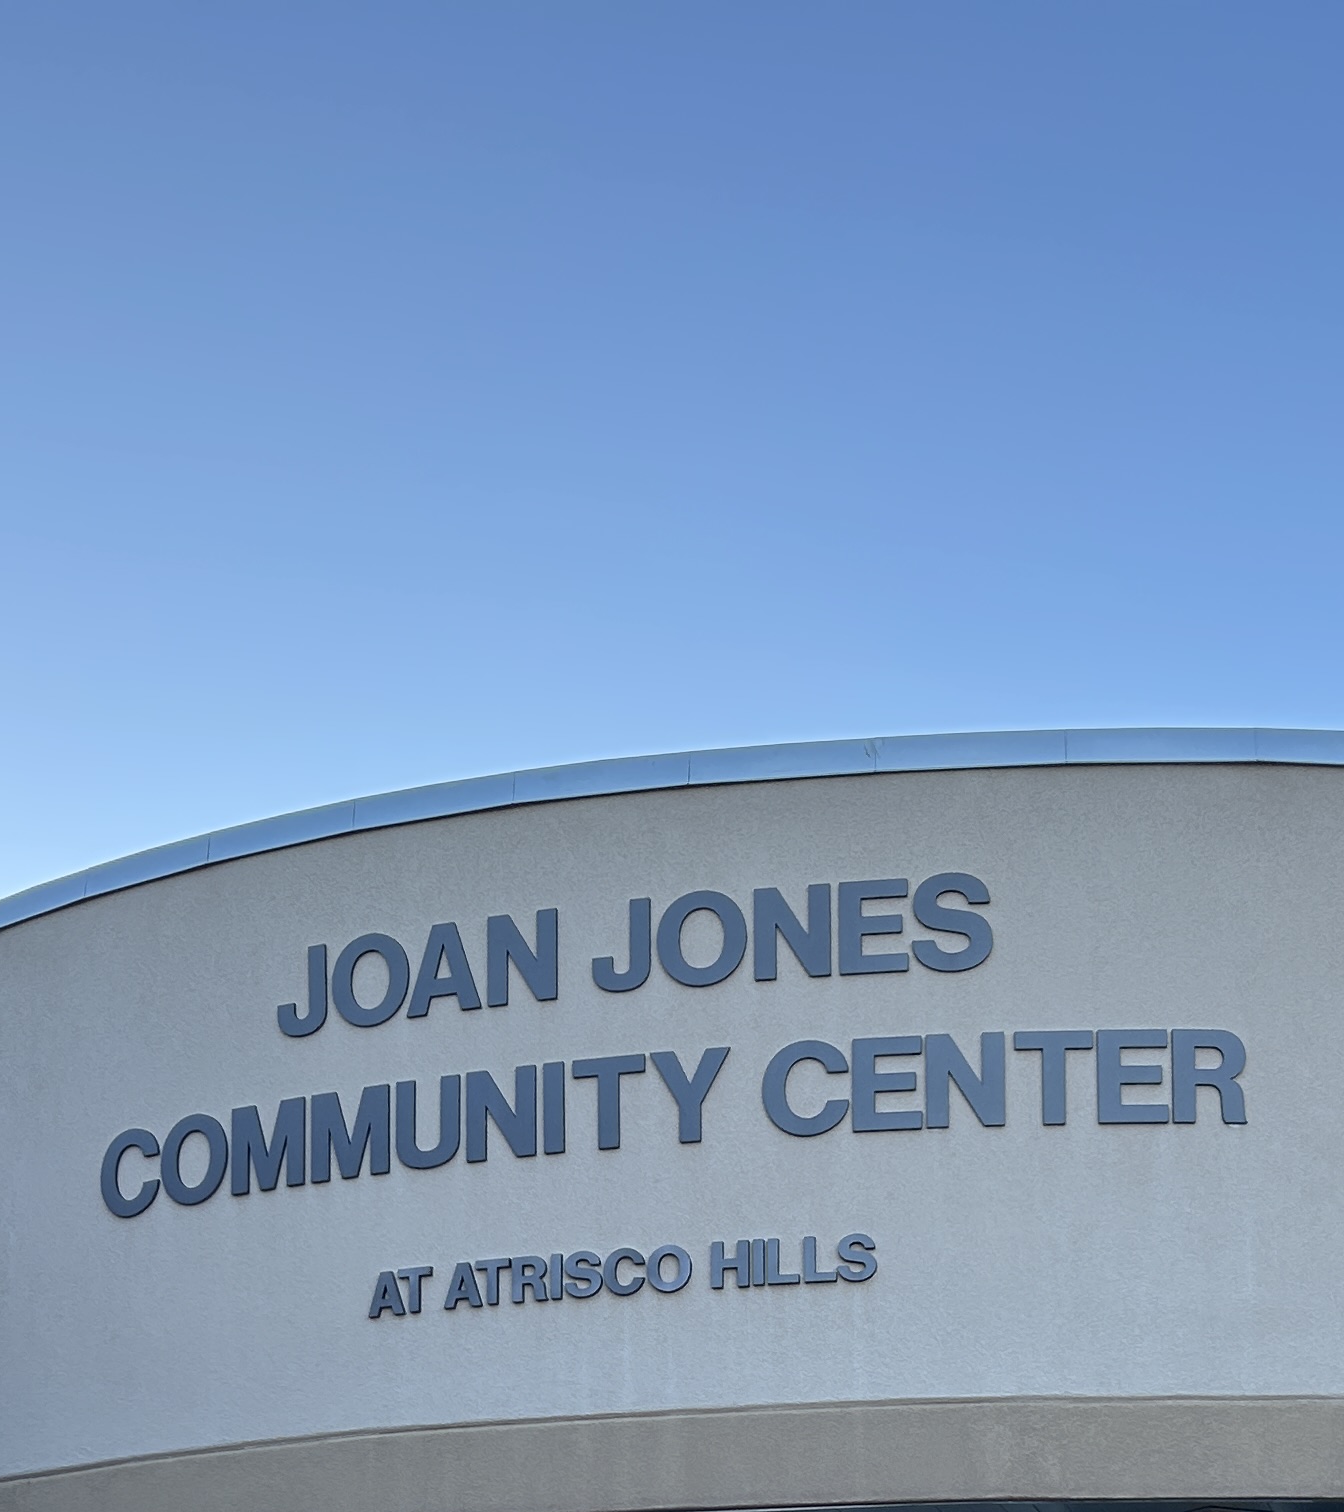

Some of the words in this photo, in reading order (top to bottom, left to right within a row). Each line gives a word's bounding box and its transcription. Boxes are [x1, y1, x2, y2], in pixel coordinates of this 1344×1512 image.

[277, 908, 558, 1039] JOAN
[592, 873, 994, 994] JONES
[100, 1047, 731, 1220] COMMUNITY
[762, 1029, 1250, 1139] CENTER
[368, 1265, 434, 1321] AT
[443, 1246, 694, 1312] ATRISCO
[710, 1233, 879, 1291] HILLS
